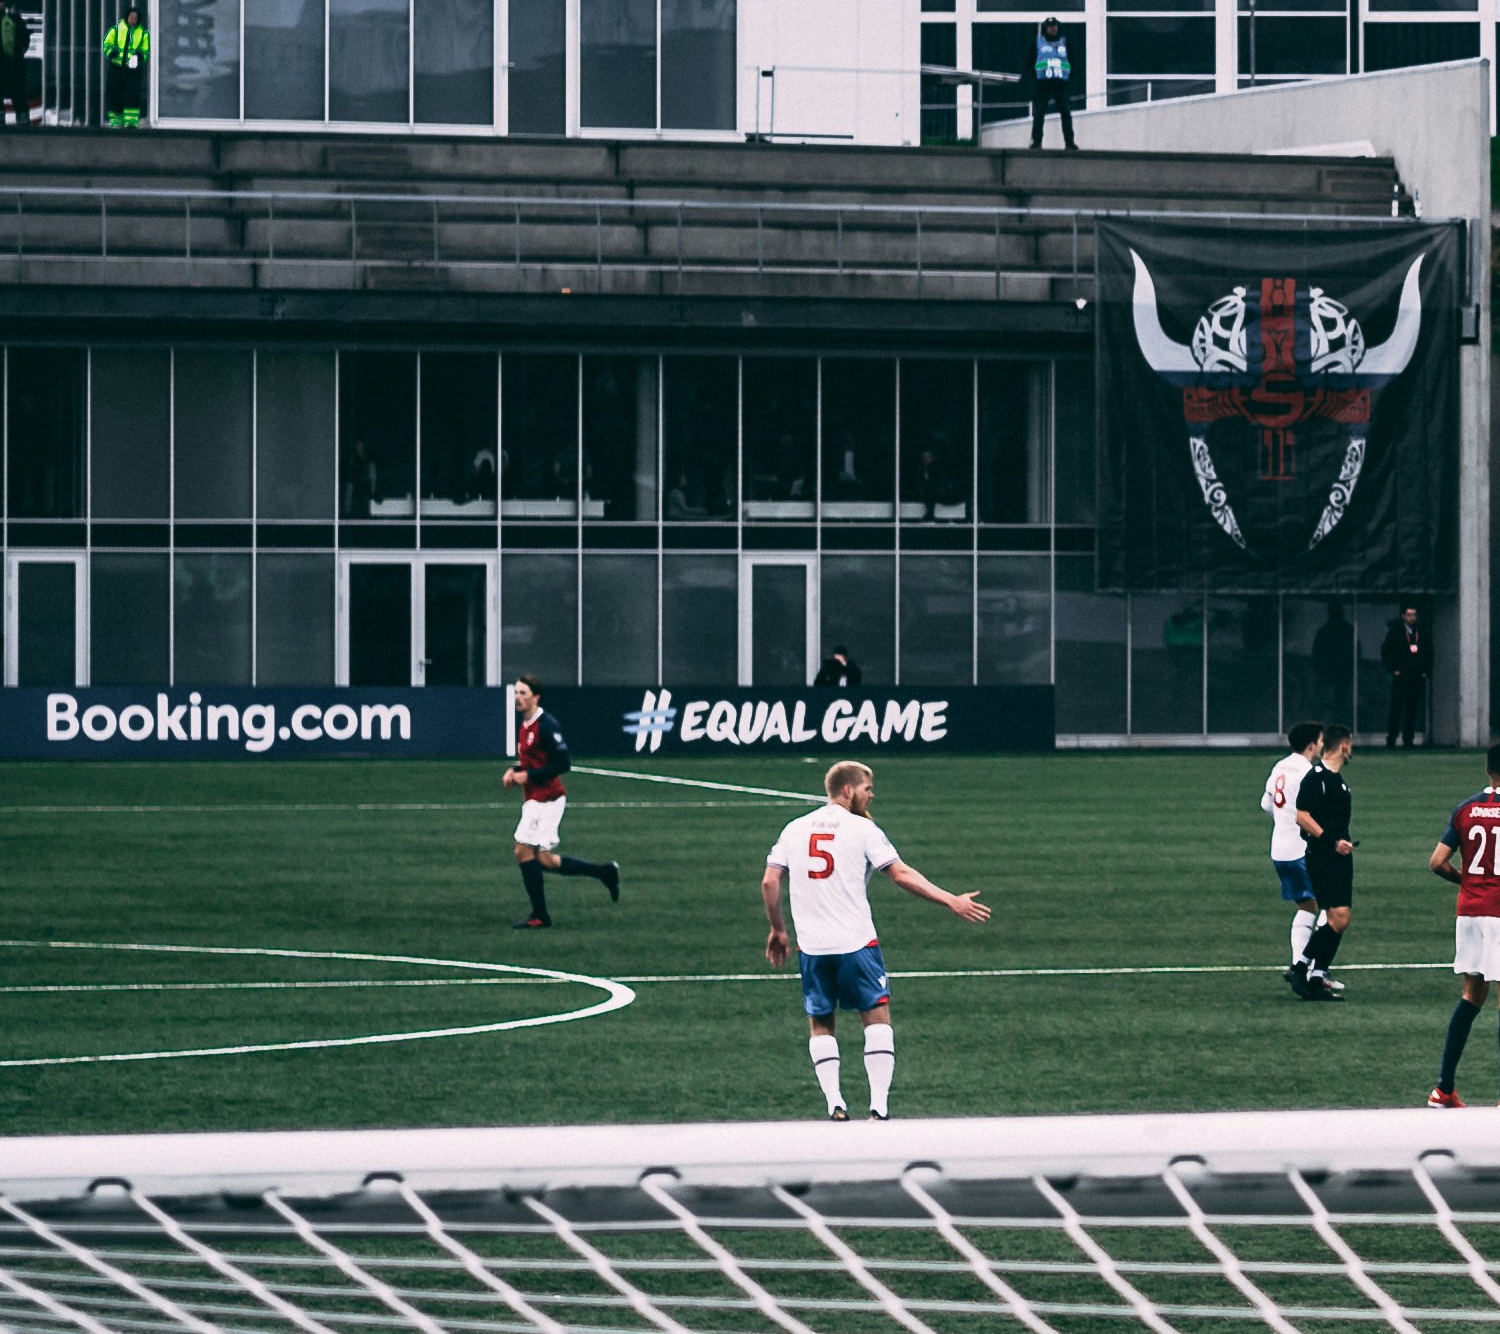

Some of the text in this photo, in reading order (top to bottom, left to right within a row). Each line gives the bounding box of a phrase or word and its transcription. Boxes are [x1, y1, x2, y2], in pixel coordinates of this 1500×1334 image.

[47, 692, 411, 752] Booking.com
[1273, 774, 1287, 809] 8
[808, 832, 836, 880] 5
